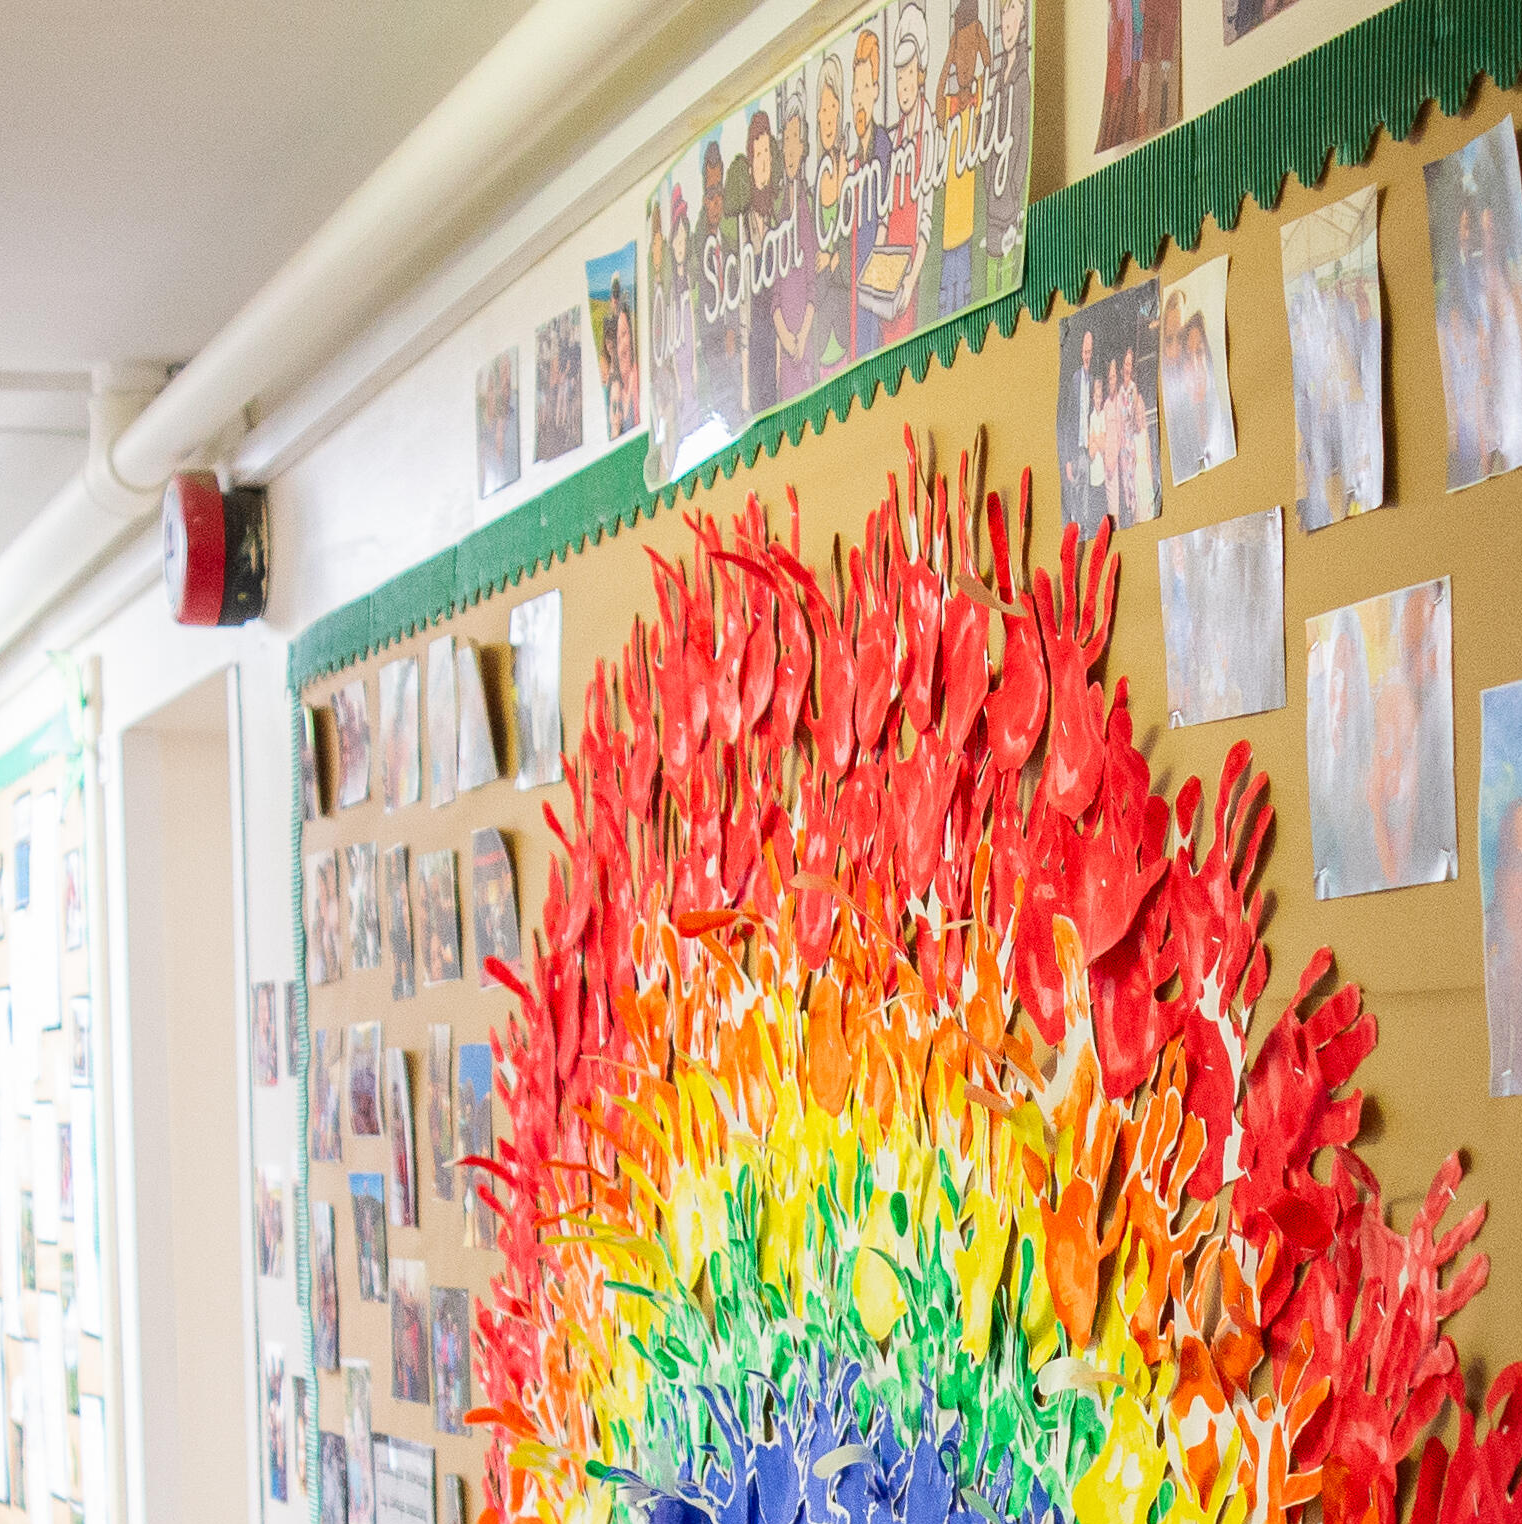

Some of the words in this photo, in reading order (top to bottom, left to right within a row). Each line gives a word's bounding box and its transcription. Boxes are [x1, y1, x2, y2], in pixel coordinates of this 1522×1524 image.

[652, 287, 691, 367] Our
[704, 179, 804, 323] School
[815, 65, 1014, 251] Community
